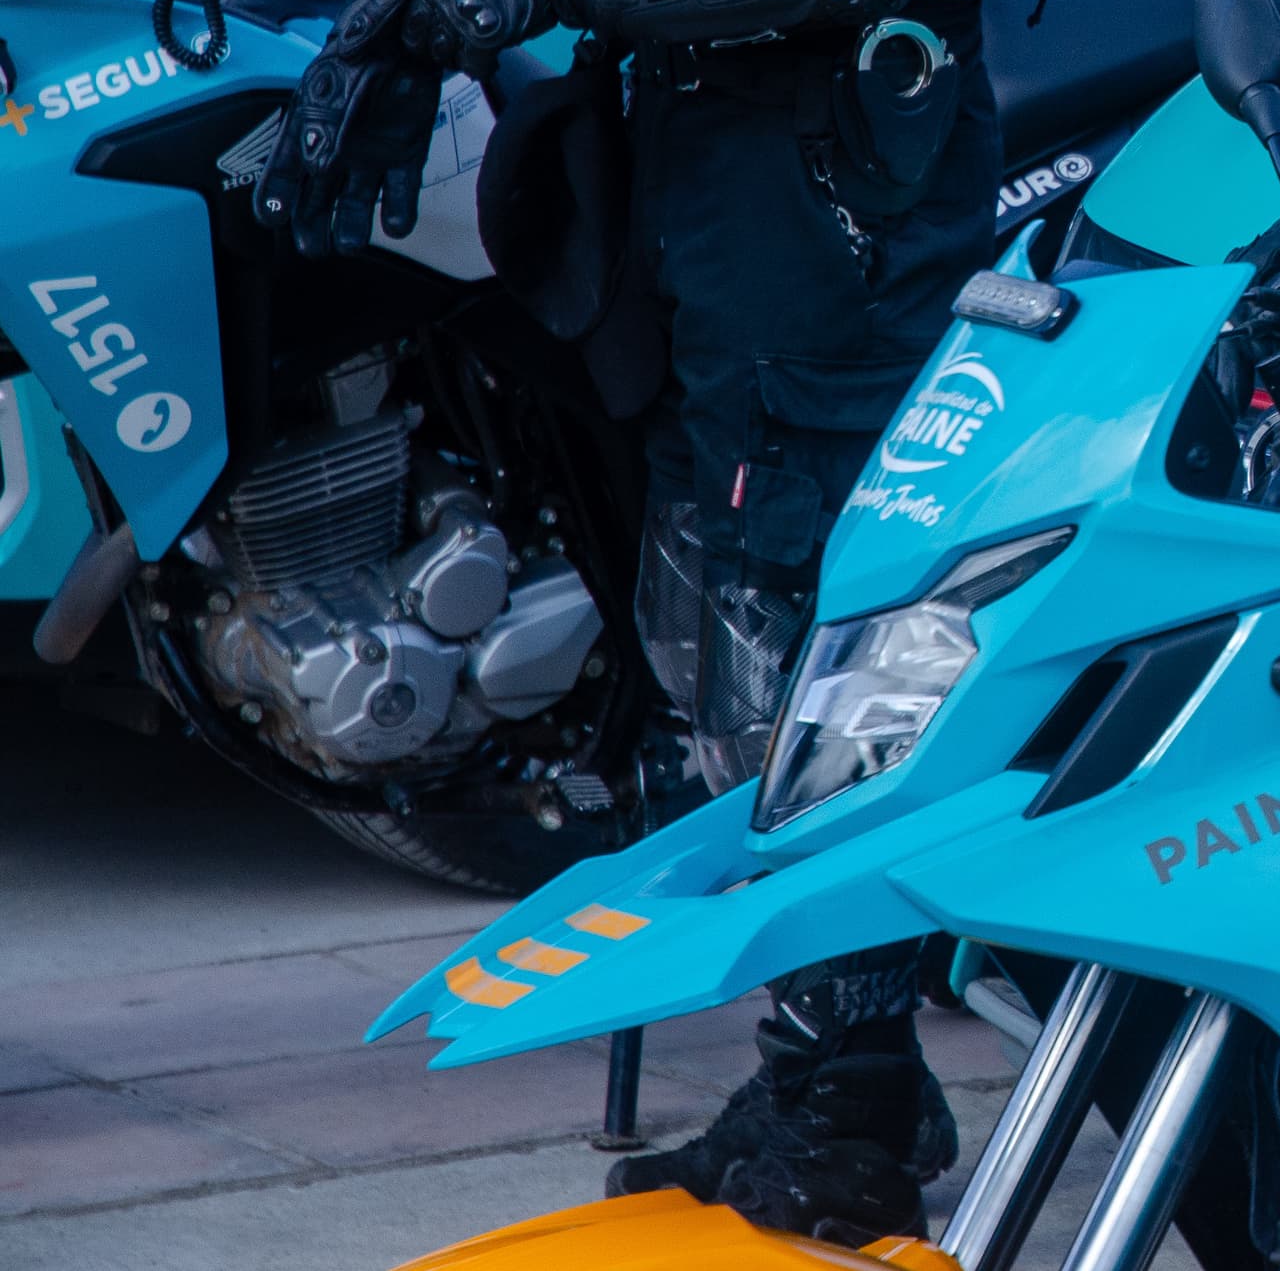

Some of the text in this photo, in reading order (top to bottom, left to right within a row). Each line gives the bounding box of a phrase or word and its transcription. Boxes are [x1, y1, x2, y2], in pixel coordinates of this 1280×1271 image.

[28, 275, 149, 397] 1517
[889, 407, 984, 456] PAINE
[878, 483, 946, 527] Juntos
